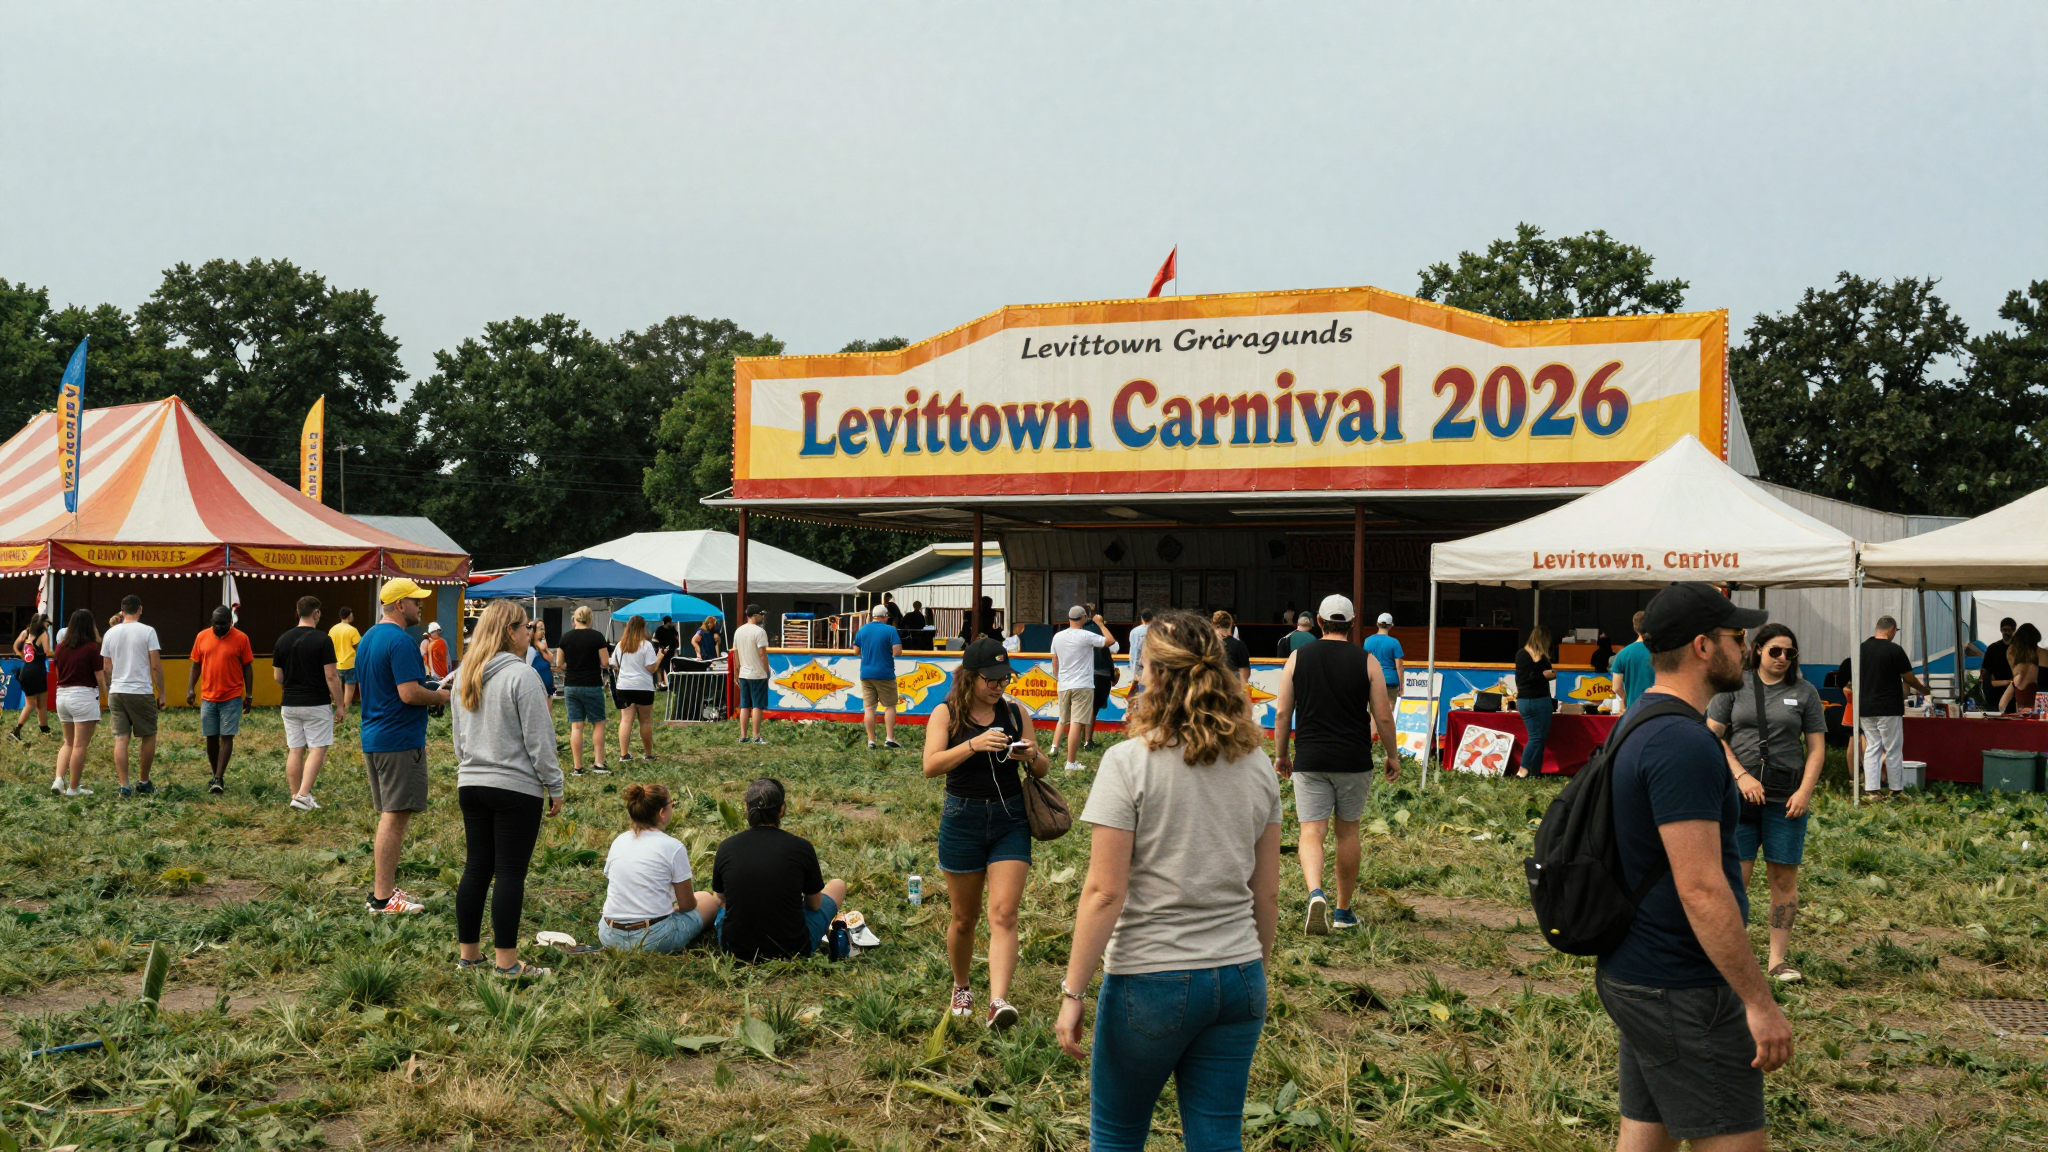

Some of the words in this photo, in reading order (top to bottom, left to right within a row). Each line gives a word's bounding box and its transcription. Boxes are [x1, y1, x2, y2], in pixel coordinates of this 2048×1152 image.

[1021, 334, 1162, 360] Levittown
[799, 386, 1094, 458] Levittown
[1110, 364, 1407, 451] Carnival
[1430, 360, 1631, 443] 2026
